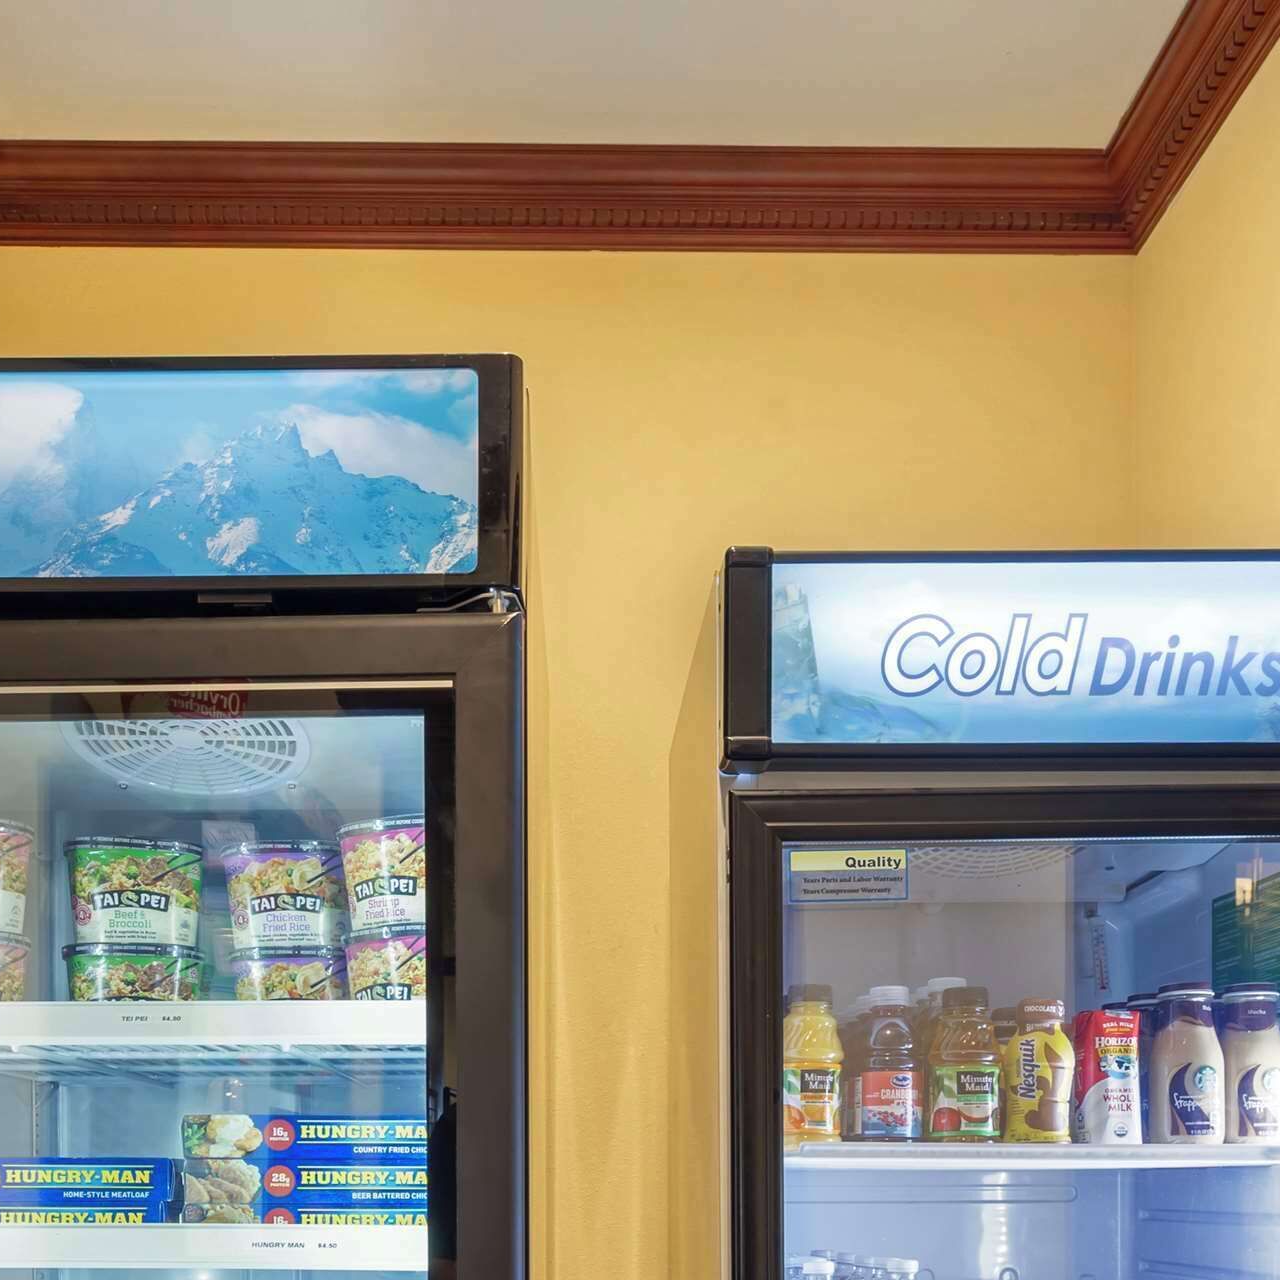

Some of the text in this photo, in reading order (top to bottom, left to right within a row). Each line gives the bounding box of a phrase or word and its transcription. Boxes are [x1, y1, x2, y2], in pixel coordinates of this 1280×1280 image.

[882, 613, 1088, 698] Cold
[845, 856, 902, 870] Quality
[354, 878, 414, 898] TAI PEI
[94, 892, 166, 910] TAI PEI
[251, 896, 320, 912] TAI PEI
[368, 898, 400, 909] Shrip
[114, 910, 138, 919] Beef
[266, 913, 306, 922] Chicken
[108, 918, 152, 928] Broccoli
[262, 922, 310, 932] Fried Rice
[356, 986, 408, 1000] TAI PEI
[1020, 1038, 1037, 1099] Nesquik
[804, 1072, 834, 1082] Minute
[960, 1074, 994, 1084] Minute
[809, 1080, 830, 1090] Maid
[965, 1082, 990, 1092] Maid
[880, 1088, 918, 1100] CRANB
[1108, 1104, 1132, 1112] MILK
[300, 1125, 428, 1139] HUNGRY-MA
[353, 1146, 428, 1154] COUNTRY FRIED CHIC
[5, 1169, 151, 1184] HUNGRY-MAN
[271, 1172, 290, 1184] 28g
[300, 1171, 428, 1185] HUNGRY-MA
[352, 1192, 428, 1200] BEER BATTERED CHIC
[0, 1212, 144, 1224] HUNGRY-MAN
[300, 1214, 428, 1225] HUNGRY-MA
